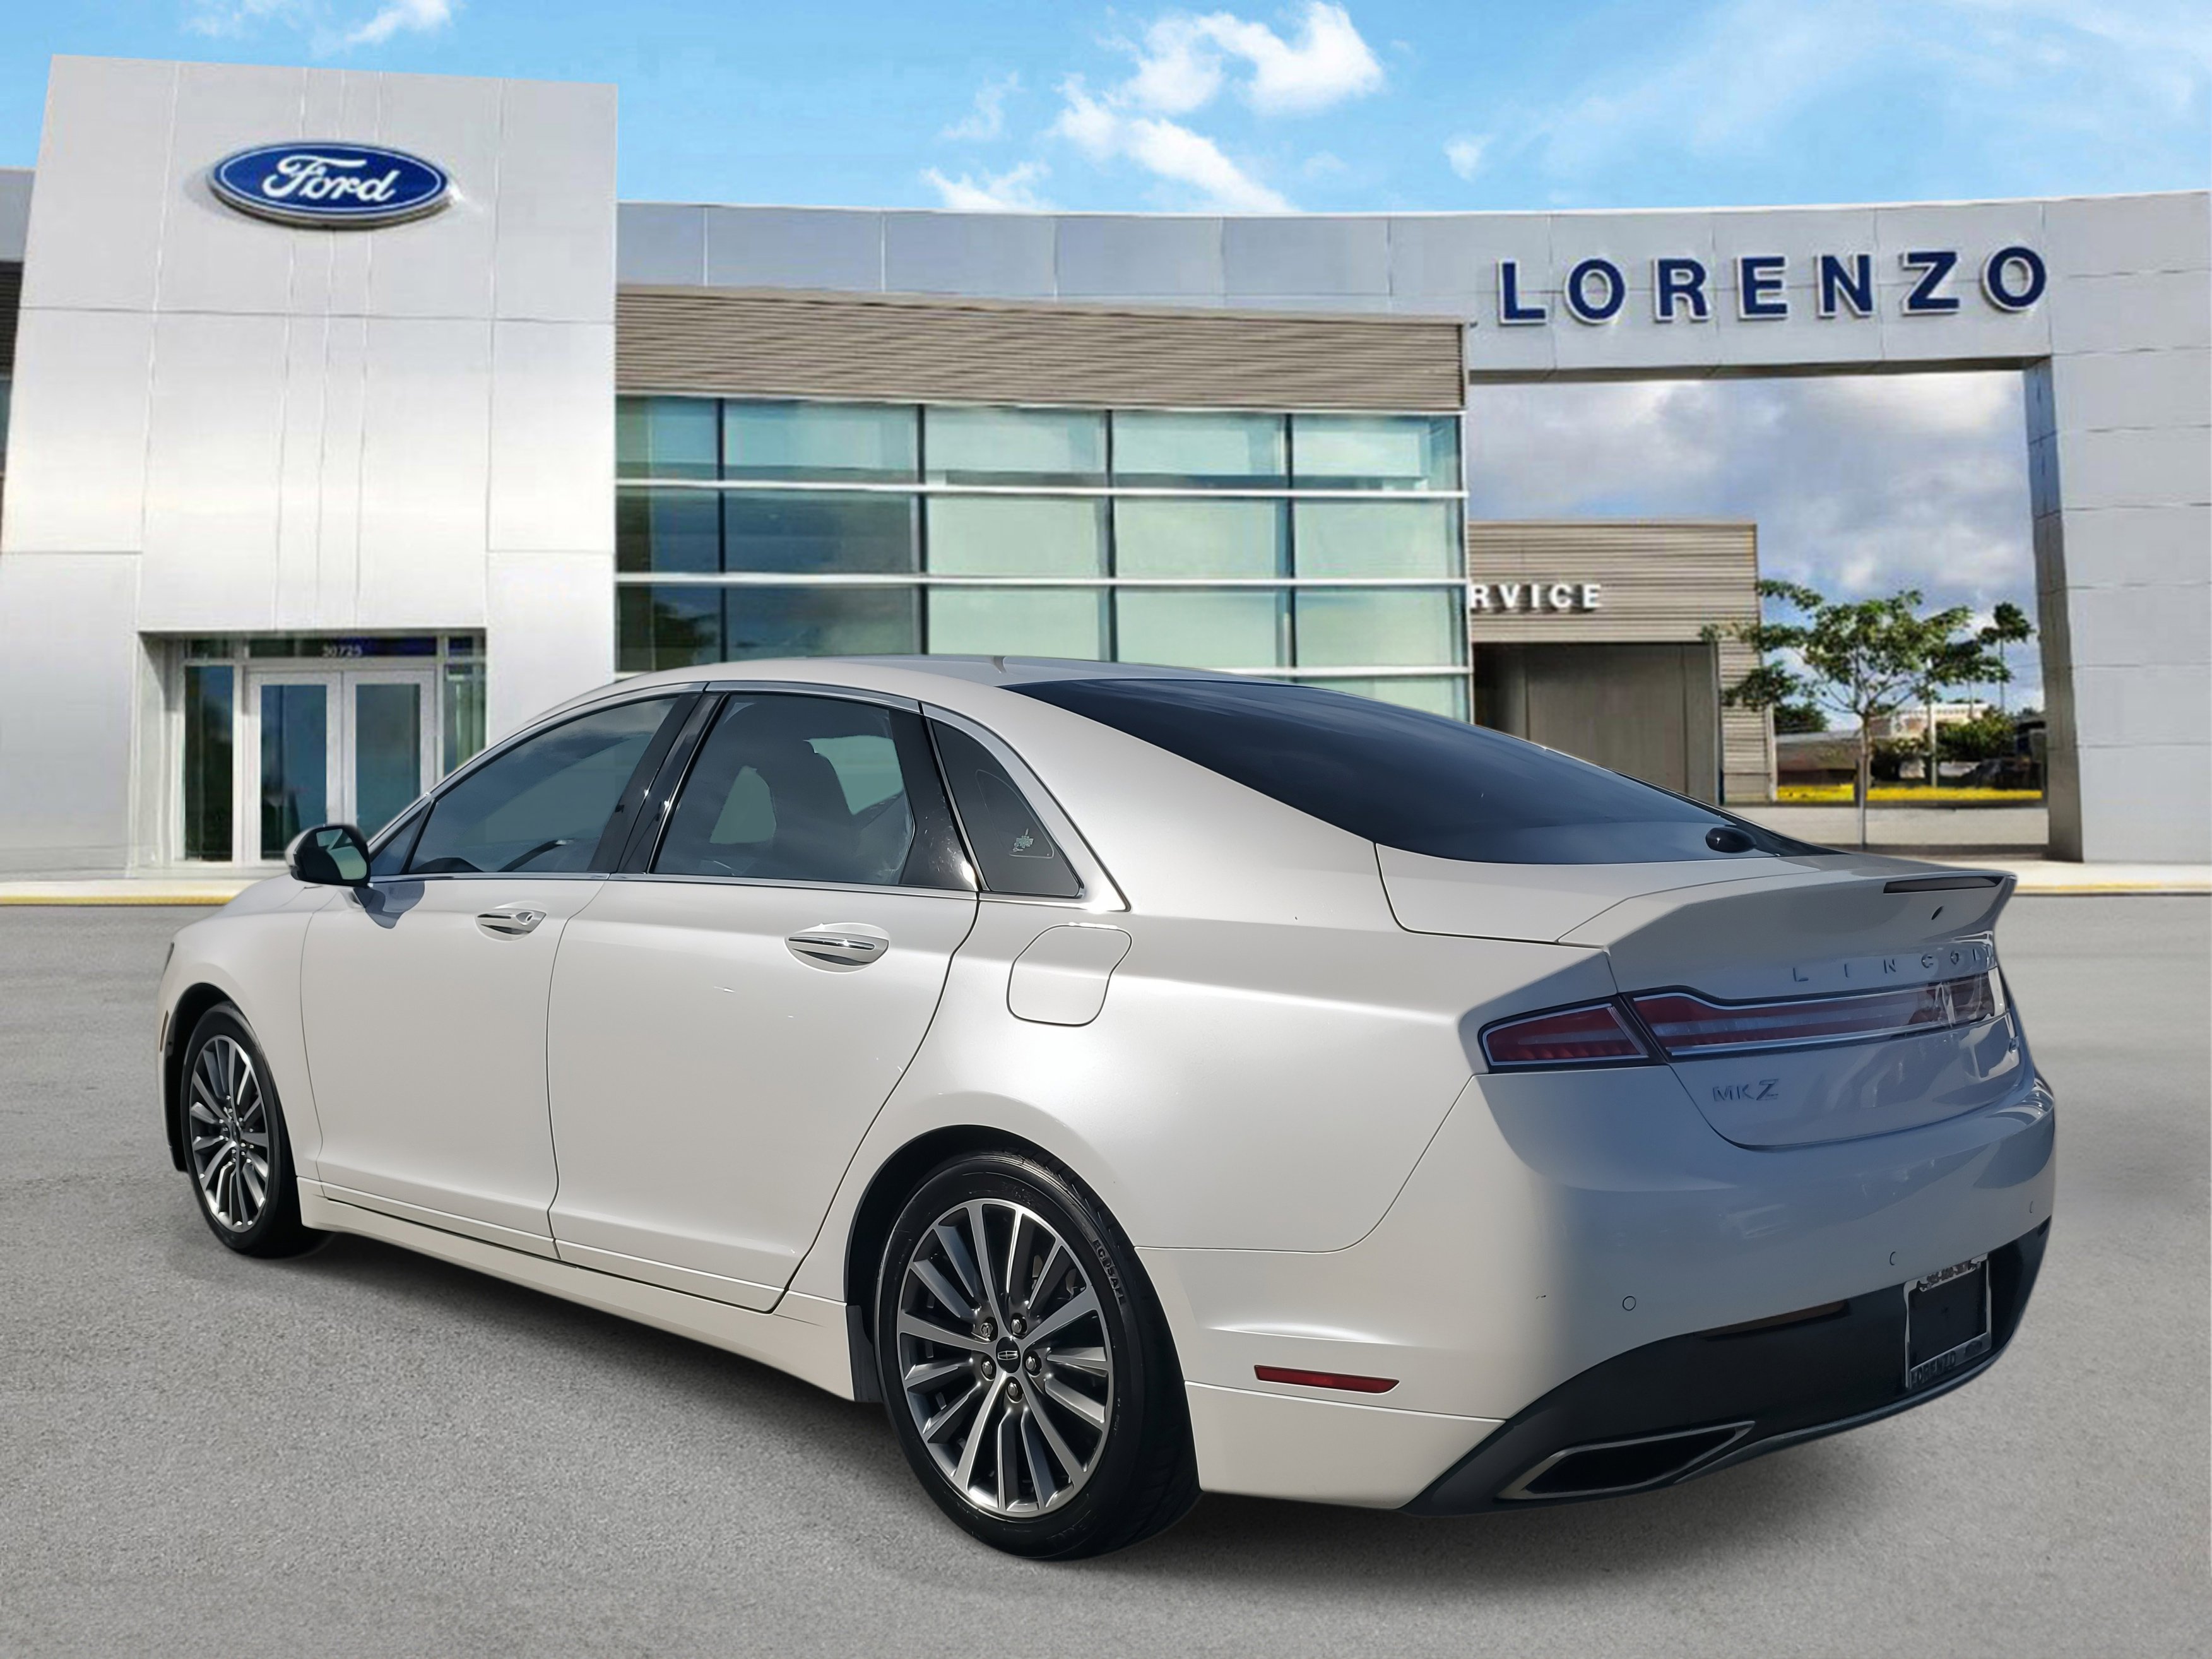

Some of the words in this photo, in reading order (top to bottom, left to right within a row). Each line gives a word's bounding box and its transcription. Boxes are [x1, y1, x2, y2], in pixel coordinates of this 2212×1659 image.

[263, 155, 400, 201] Ford
[1499, 247, 2046, 324] LORENZO
[1793, 948, 1989, 982] LINCOL
[1712, 1078, 1778, 1102] MKZ
